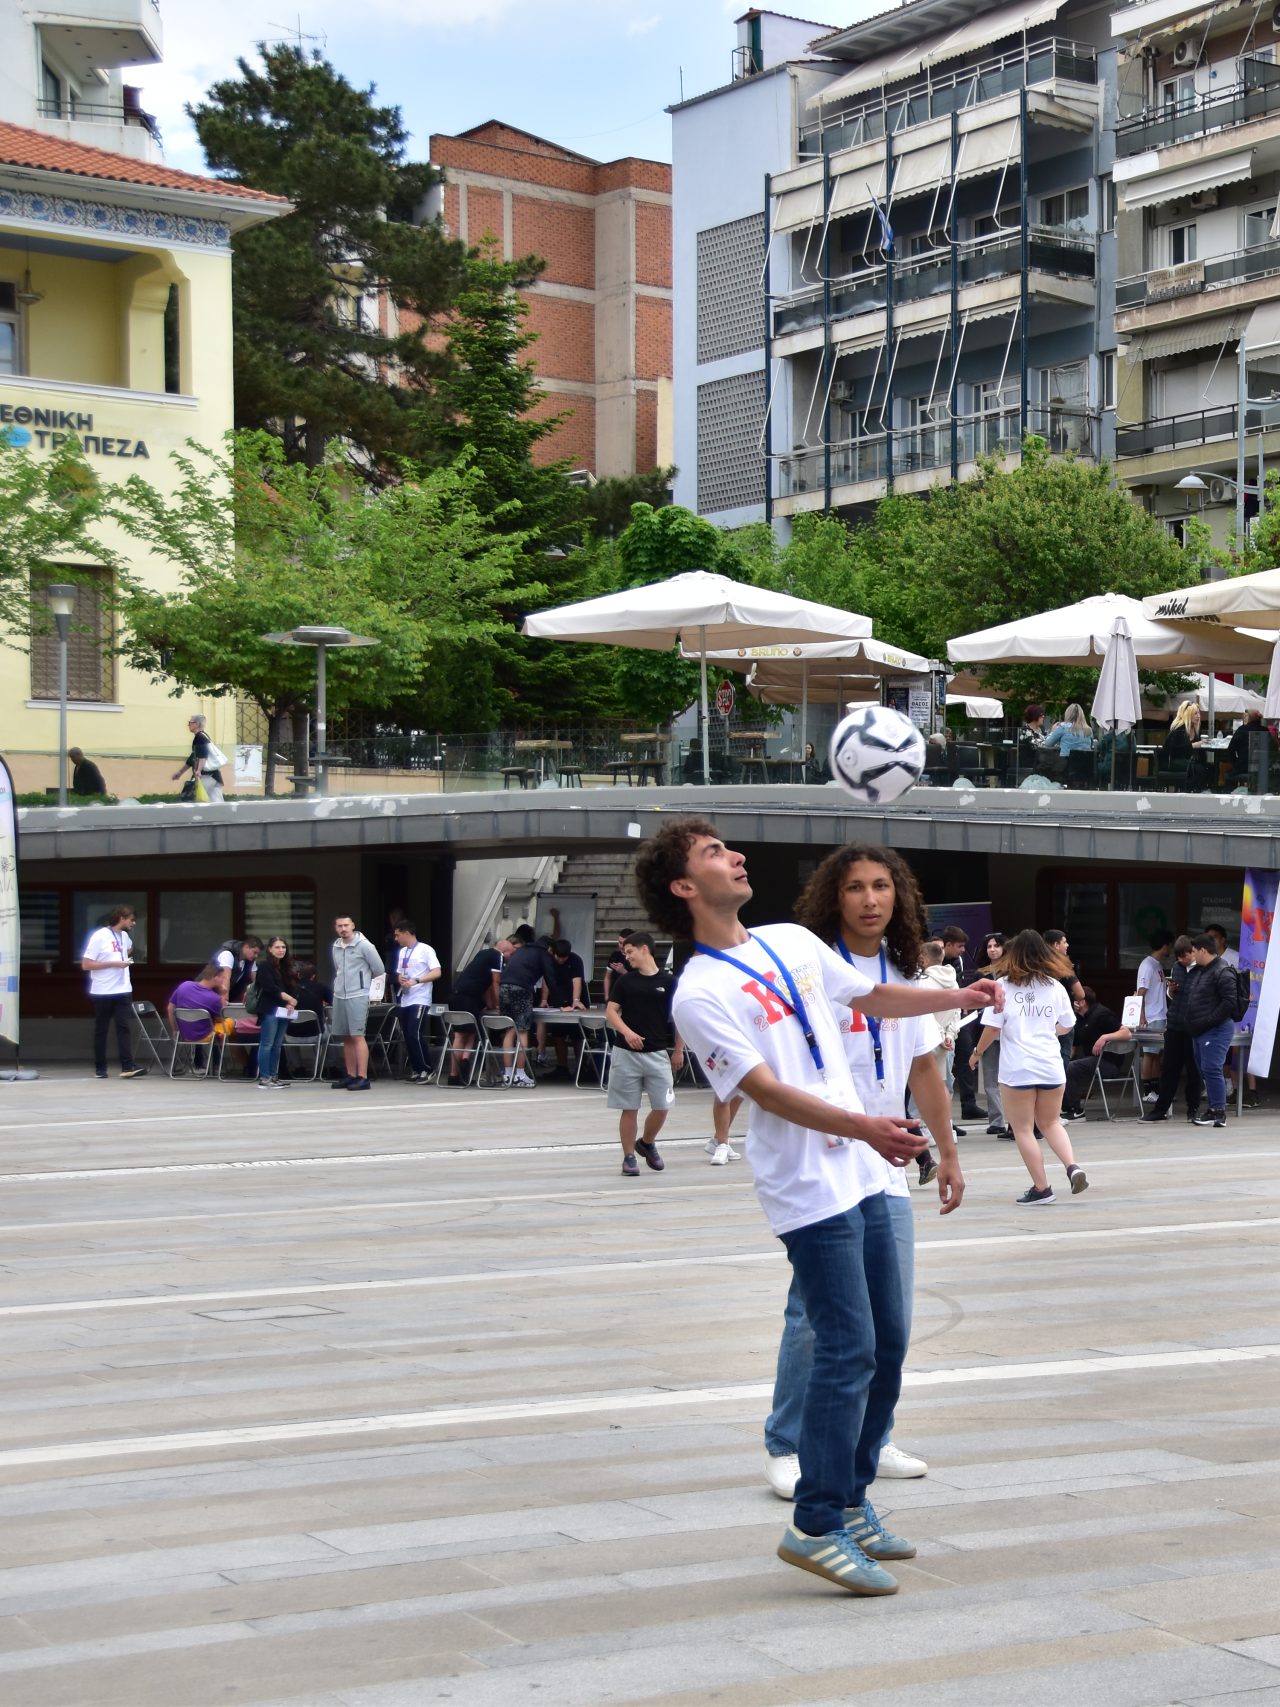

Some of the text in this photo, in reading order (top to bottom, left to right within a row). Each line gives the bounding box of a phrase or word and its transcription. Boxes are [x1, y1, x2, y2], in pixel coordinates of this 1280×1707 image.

[0, 403, 94, 431] ΕΘΝΙΚΗ
[34, 430, 150, 459] ΤΡΠΕΖΑ
[1155, 597, 1189, 616] mikel
